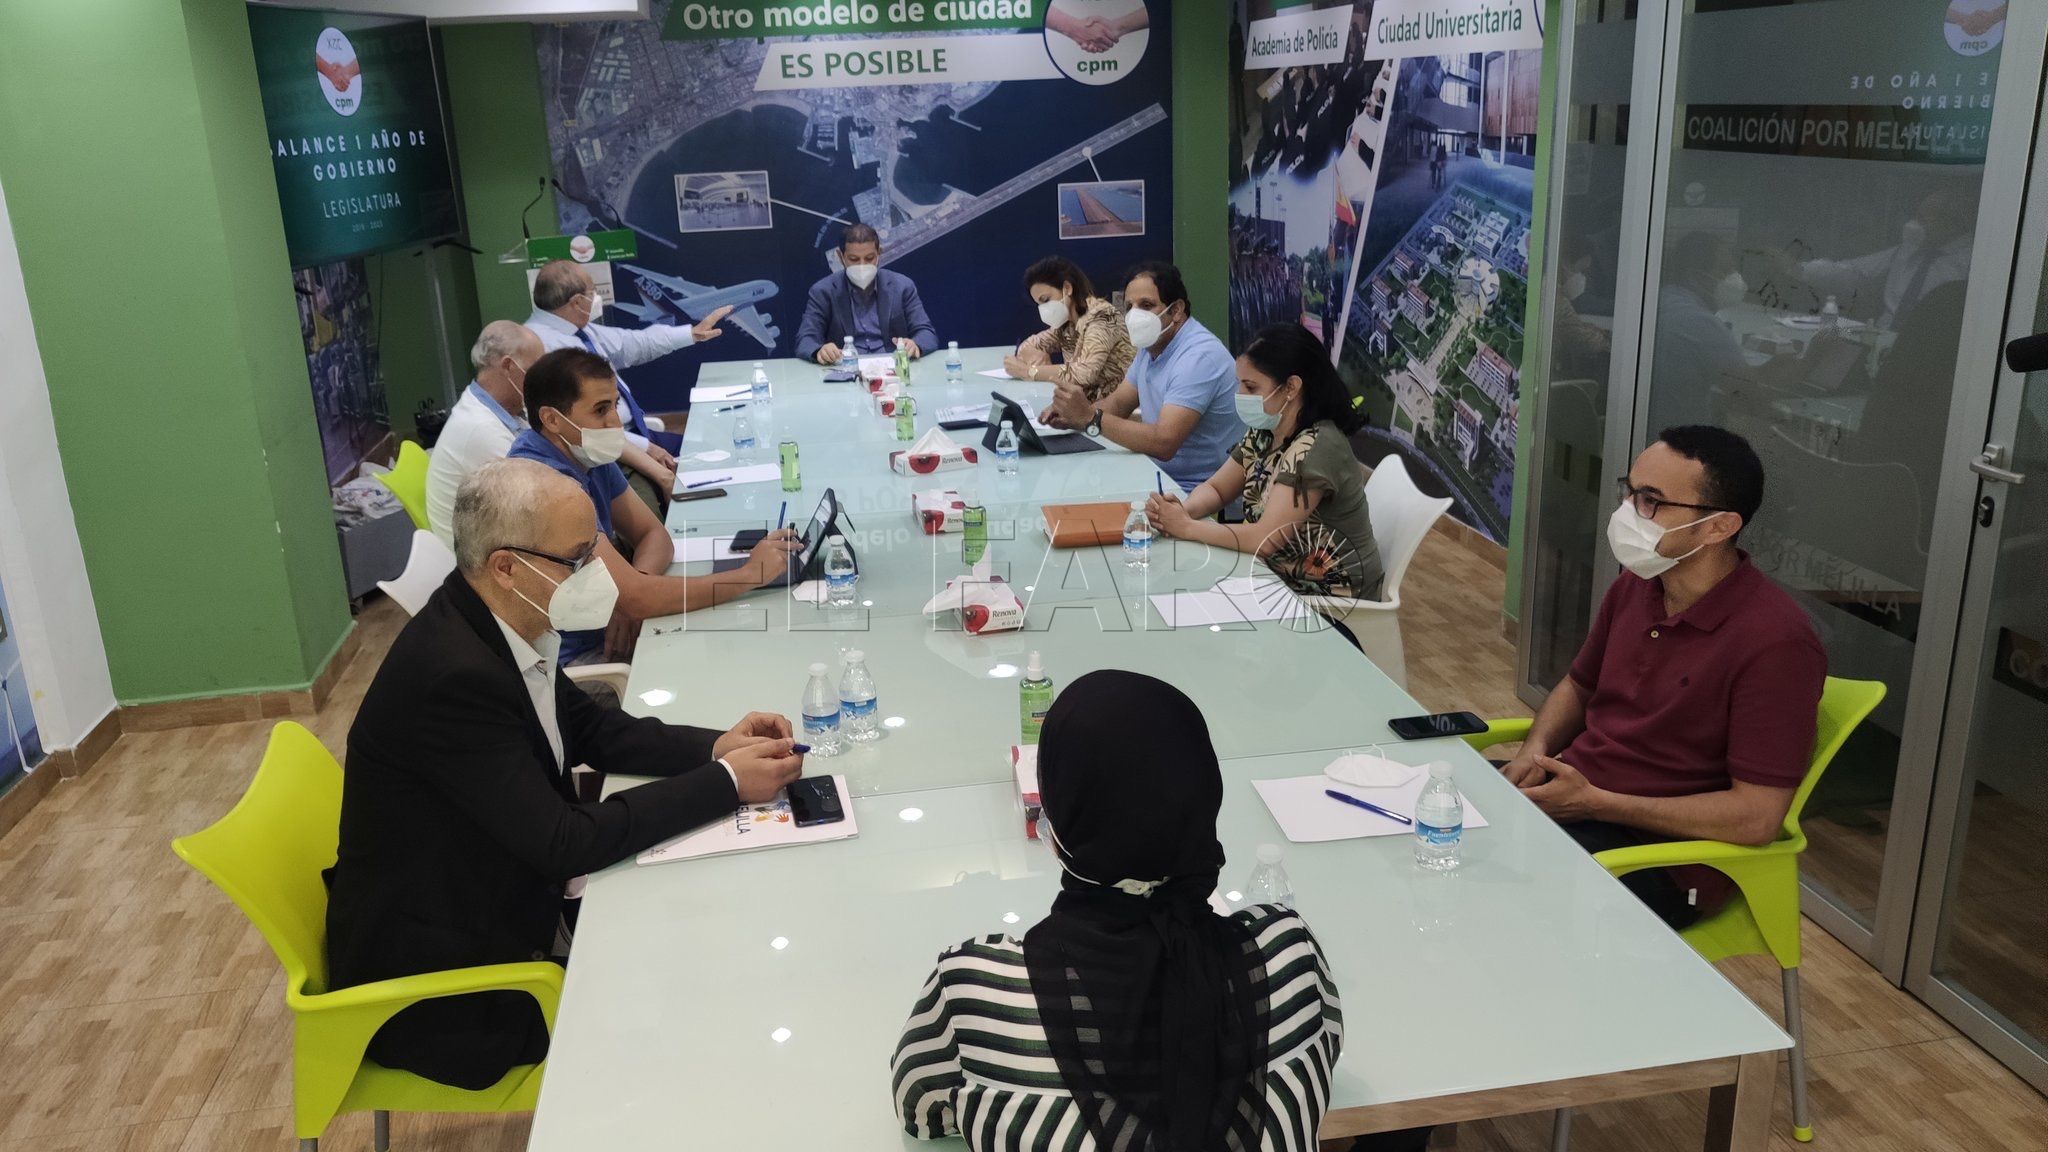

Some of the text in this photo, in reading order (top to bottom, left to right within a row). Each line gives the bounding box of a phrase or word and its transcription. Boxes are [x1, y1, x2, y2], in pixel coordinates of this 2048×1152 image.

[683, 0, 1033, 31] Otro modelo de ciudad
[1377, 1, 1522, 45] Ciudad Universitaria
[1251, 25, 1338, 58] Academia de Policía
[780, 49, 948, 80] ES POSIBLE
[1076, 56, 1119, 77] cpm
[335, 97, 354, 110] cpm
[277, 135, 346, 157] ALANCE
[371, 129, 401, 149] AÑO
[409, 130, 426, 146] DE
[1687, 112, 1795, 144] COALICIÓN
[1801, 119, 1850, 148] POR
[313, 157, 397, 182] GOBIERNO
[323, 192, 402, 219] LEGISLATURA
[634, 275, 663, 301] A380
[992, 608, 1017, 619] Renova
